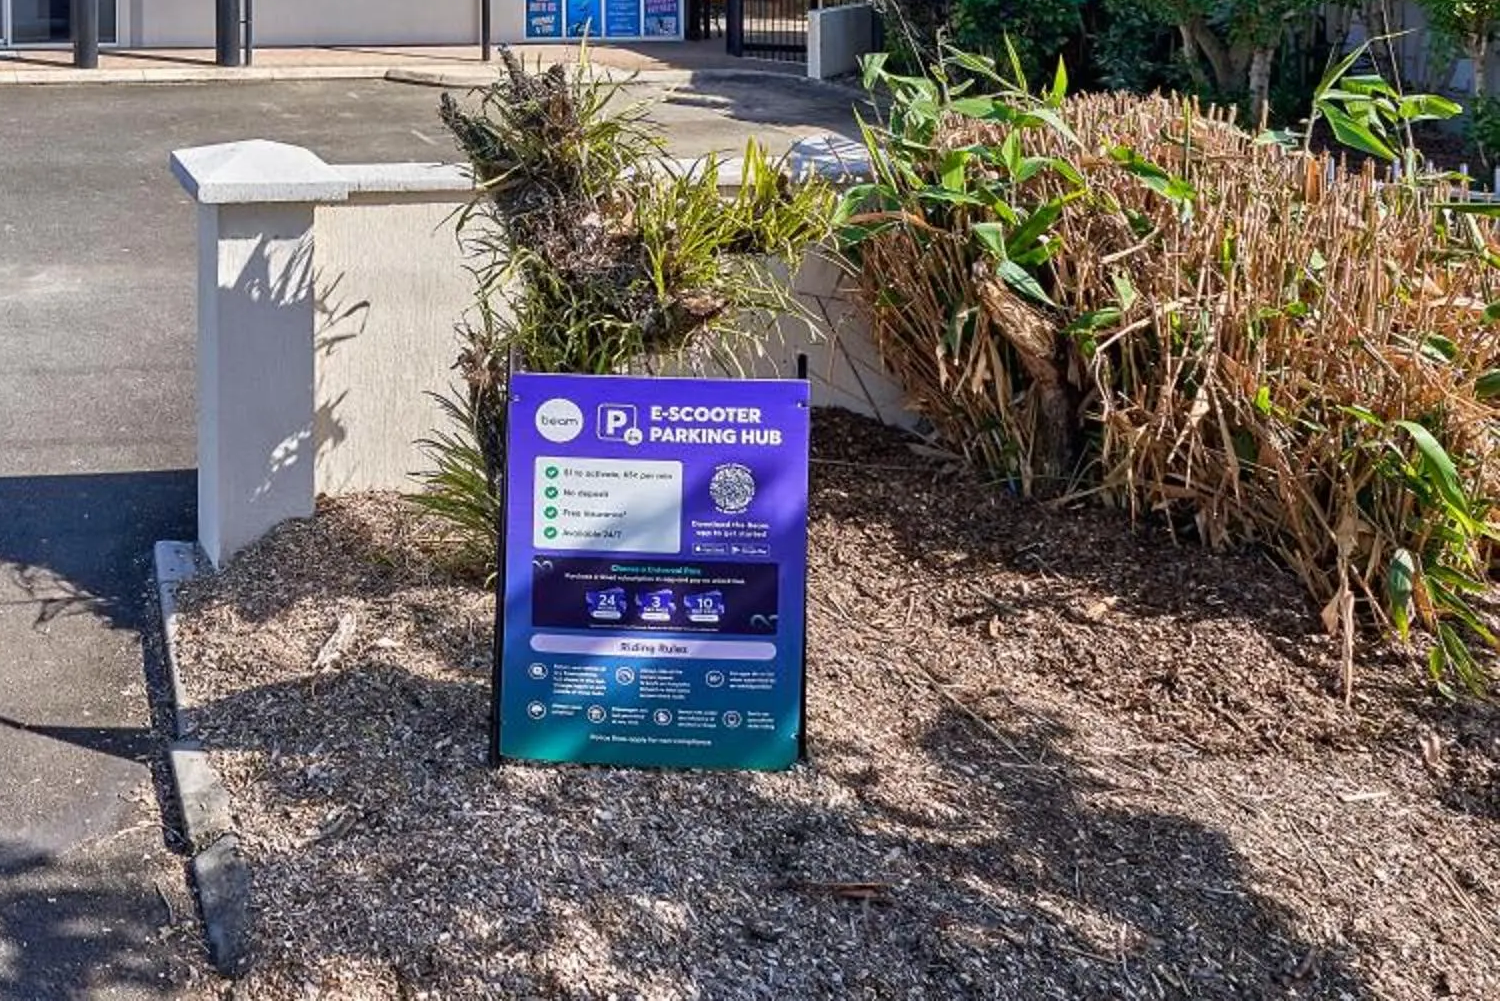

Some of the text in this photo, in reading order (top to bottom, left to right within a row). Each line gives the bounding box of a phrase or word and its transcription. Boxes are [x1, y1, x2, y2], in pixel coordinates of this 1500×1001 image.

[541, 414, 579, 427] beam
[651, 406, 762, 424] E-SCOOTER
[606, 409, 629, 436] P
[650, 427, 783, 446] PARKING HUB
[599, 594, 616, 606] 24
[651, 596, 661, 608] 3
[697, 598, 713, 609] 10
[620, 642, 689, 655] Riding Rules
